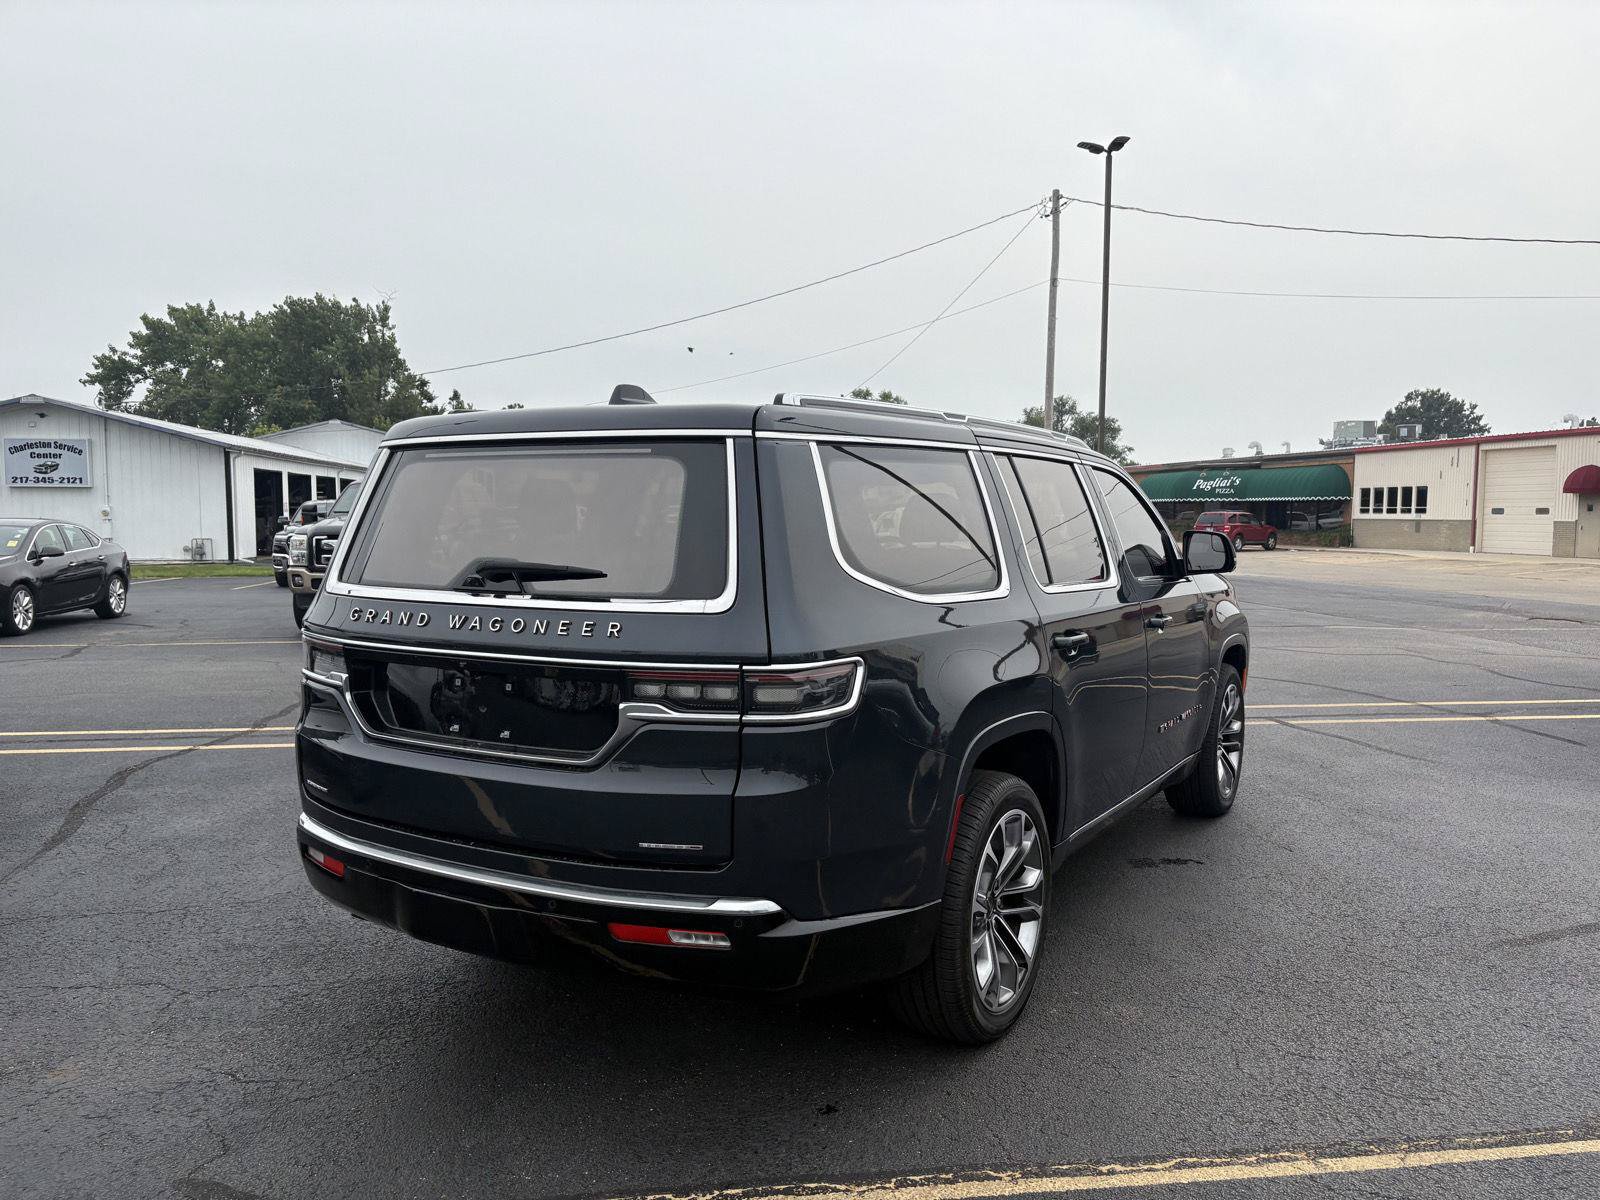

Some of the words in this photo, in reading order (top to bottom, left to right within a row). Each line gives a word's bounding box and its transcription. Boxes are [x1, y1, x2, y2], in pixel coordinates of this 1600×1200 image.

[8, 440, 52, 455] Charleston
[53, 440, 83, 456] Service
[30, 451, 63, 459] Center
[11, 476, 83, 484] 217-345-2121
[1192, 476, 1241, 491] Pagliai's
[349, 607, 431, 627] GRAND
[449, 614, 622, 638] WAGONEER
